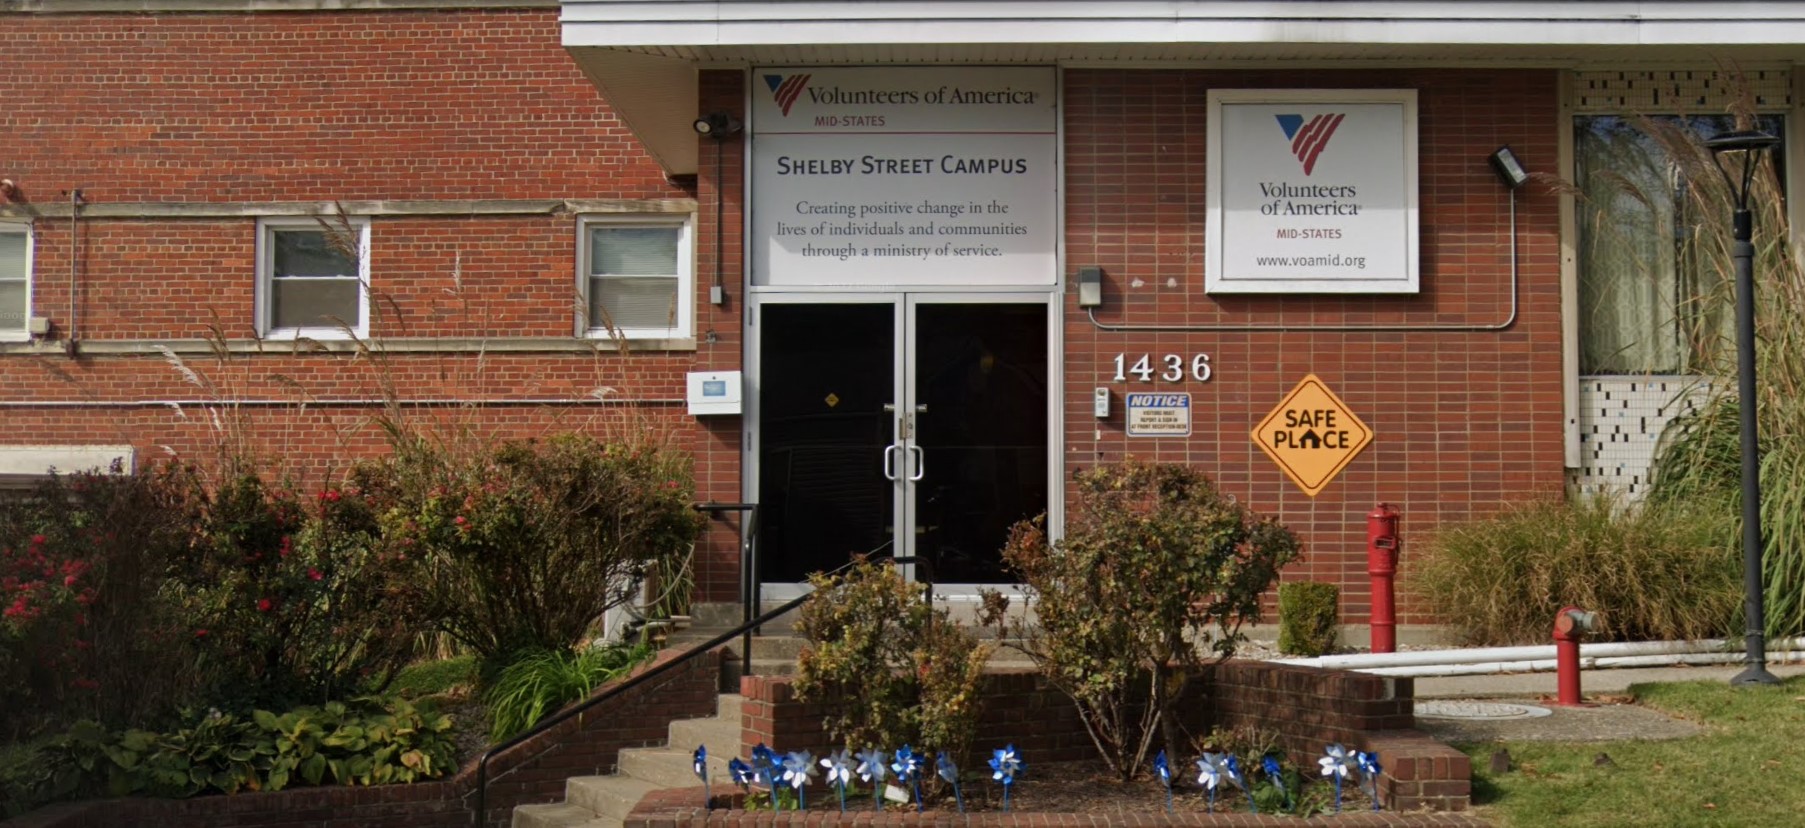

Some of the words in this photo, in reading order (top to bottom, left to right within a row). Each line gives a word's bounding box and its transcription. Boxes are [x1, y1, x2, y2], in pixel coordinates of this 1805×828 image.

[808, 86, 919, 105] Volunteers
[924, 86, 947, 105] of
[814, 115, 885, 127] MID-STATES
[777, 156, 855, 175] SHELBY
[861, 155, 934, 175] STREET
[941, 155, 1027, 175] CAMPUS
[1259, 182, 1356, 198] Volunteers
[796, 200, 856, 218] Creating
[860, 201, 913, 218] positive
[917, 200, 964, 218] change
[969, 201, 983, 214] in
[987, 200, 1009, 214] the
[1261, 200, 1282, 216] of
[777, 222, 806, 236] lives
[810, 221, 826, 236] of
[829, 221, 904, 236] individuals
[909, 221, 934, 236] and
[938, 223, 1028, 236] communities
[1276, 228, 1342, 239] MID-STATES
[802, 243, 857, 261] through
[861, 247, 869, 257] a
[873, 243, 931, 261] ministry
[935, 242, 951, 257] of
[953, 244, 1003, 257] service.
[1257, 254, 1366, 269] www.voamid.org
[1113, 353, 1211, 381] 1436
[1131, 395, 1187, 406] NOTICE
[1285, 409, 1336, 428] SAFE
